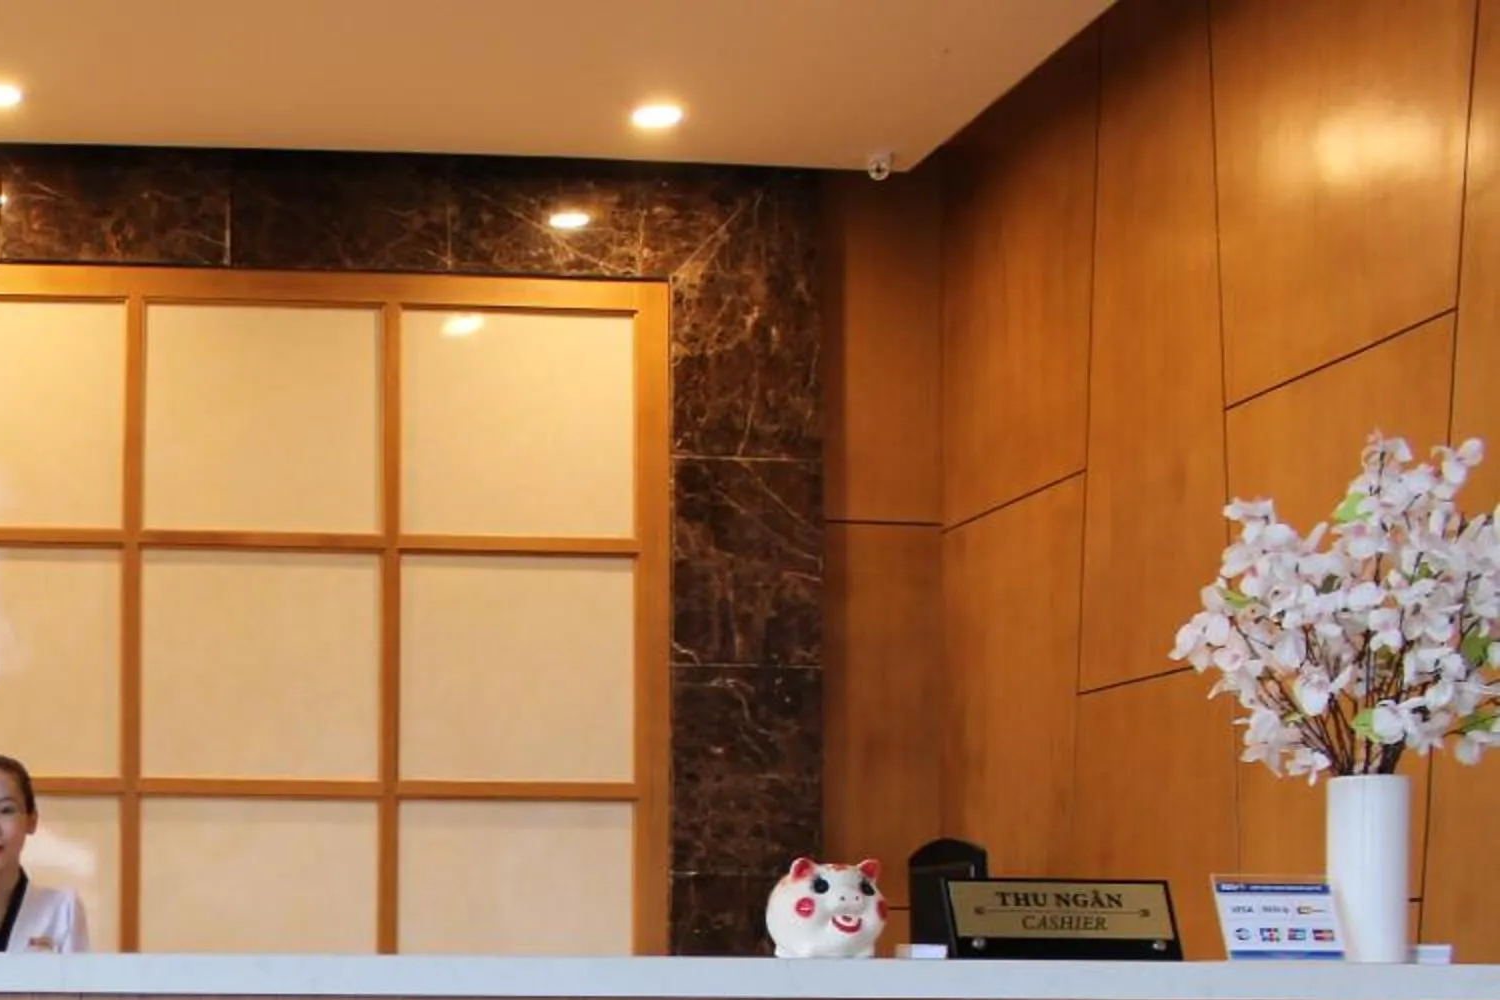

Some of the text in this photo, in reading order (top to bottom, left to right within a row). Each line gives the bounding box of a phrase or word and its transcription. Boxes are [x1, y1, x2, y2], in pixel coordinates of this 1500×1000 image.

[996, 889, 1123, 908] THU NGÂN
[1021, 915, 1108, 931] CASHIER
